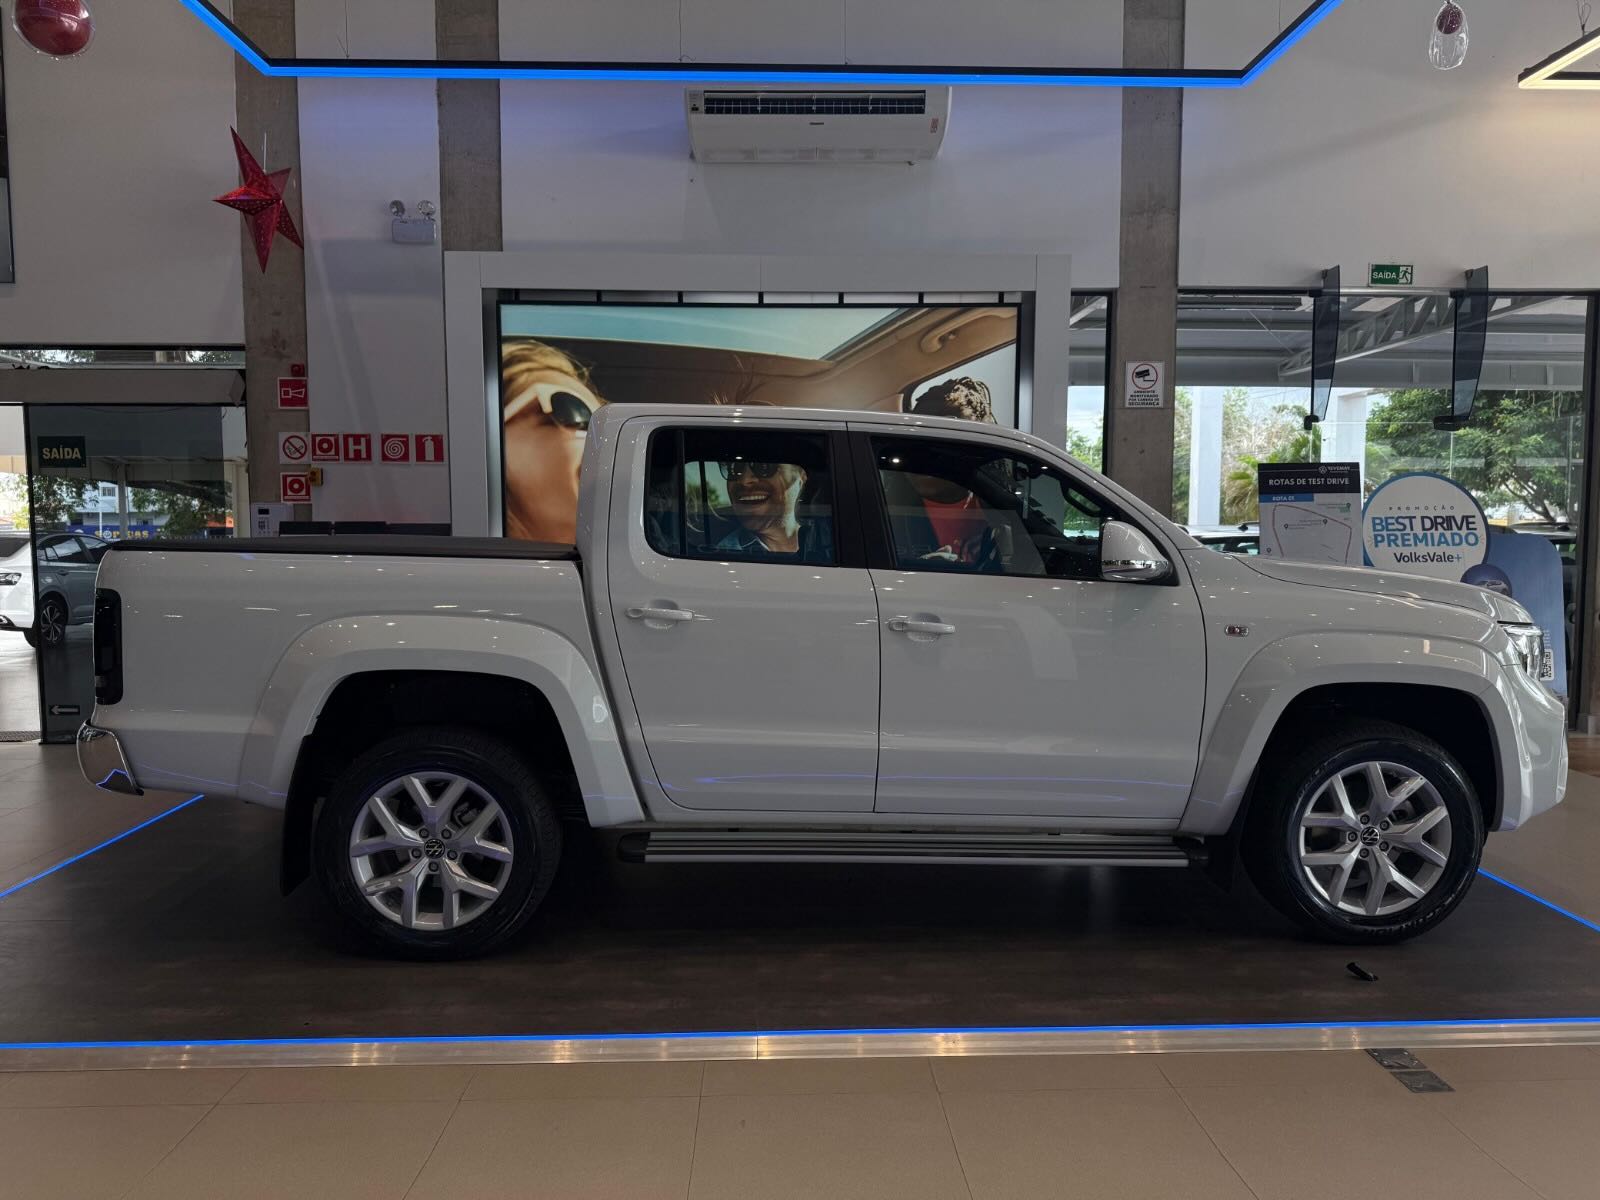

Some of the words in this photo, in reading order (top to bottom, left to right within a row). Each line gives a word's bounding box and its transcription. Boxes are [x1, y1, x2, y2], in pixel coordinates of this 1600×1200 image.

[1372, 270, 1397, 279] SAÍDA
[42, 445, 81, 459] SAÍDA
[1326, 477, 1350, 485] DRIVE
[1372, 515, 1416, 532] BEST
[1420, 515, 1477, 531] DRIVE
[1373, 532, 1480, 548] PREMIADO
